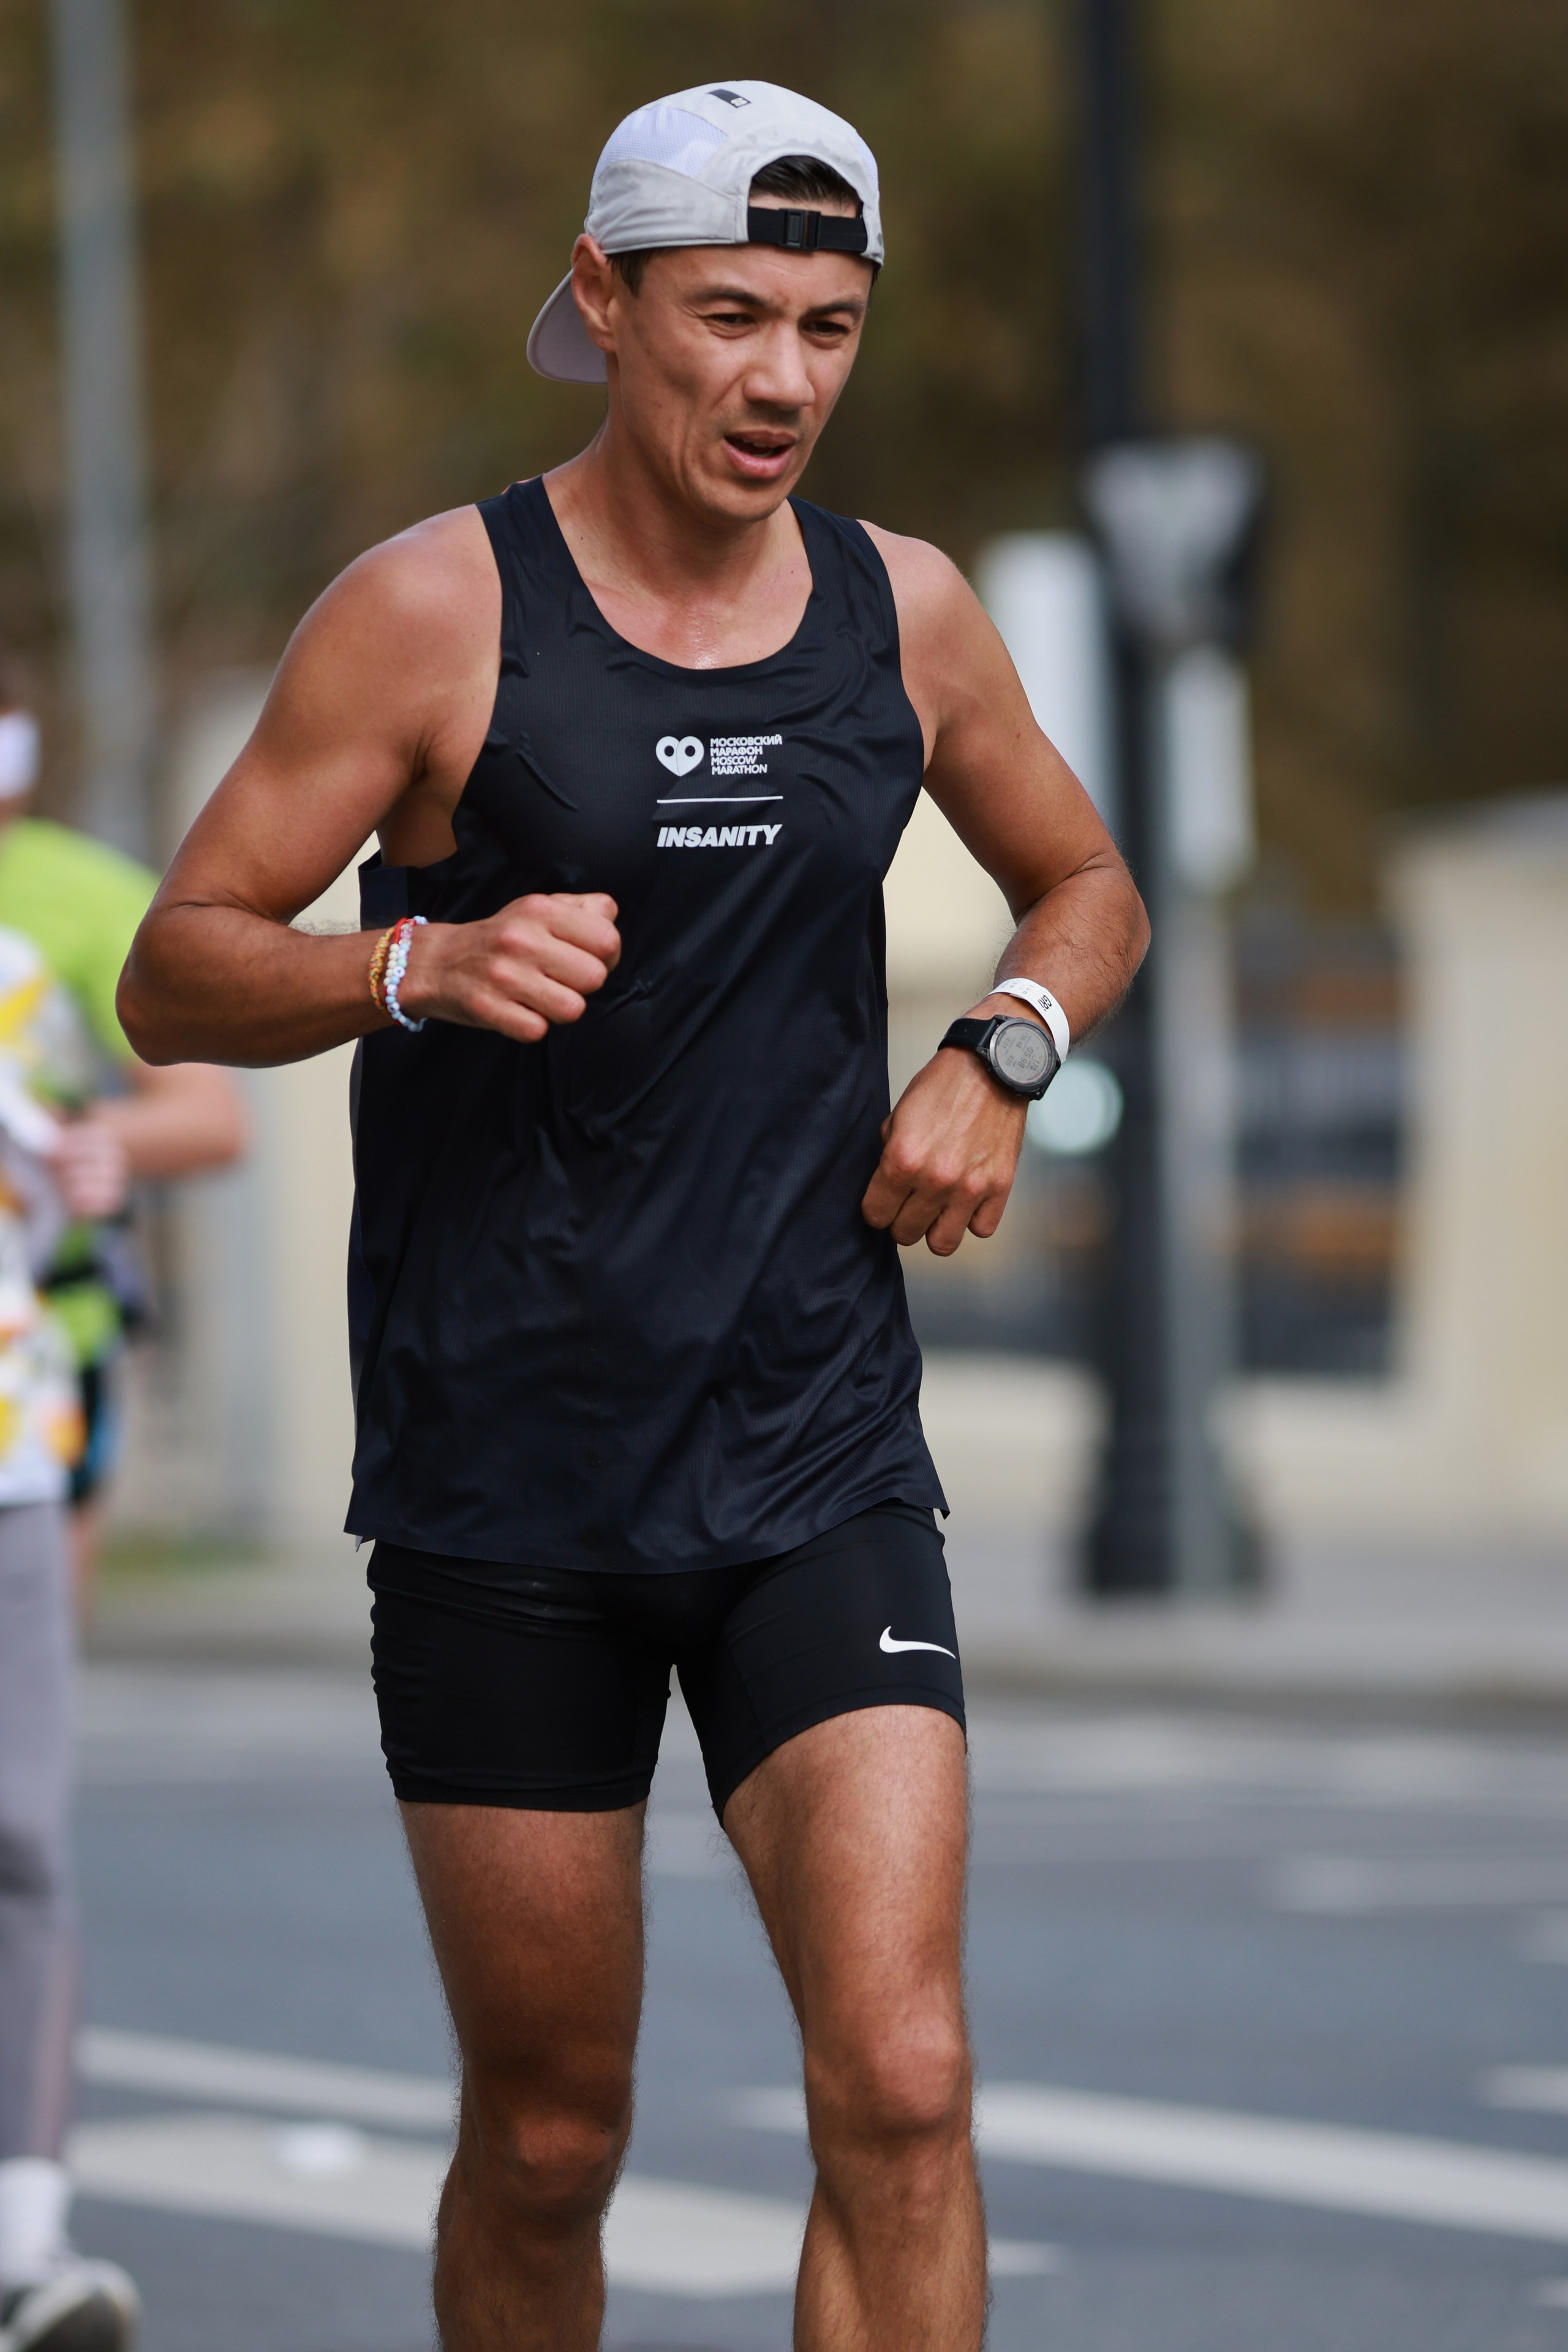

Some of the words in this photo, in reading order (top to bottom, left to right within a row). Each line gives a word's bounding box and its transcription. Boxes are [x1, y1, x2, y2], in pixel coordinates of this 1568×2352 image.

[710, 734, 783, 747] МОСКОВСКИЙ
[710, 746, 763, 756] МАРАФОН
[711, 755, 757, 766] MOSCOW
[712, 764, 767, 775] MARATHON
[657, 824, 783, 848] INSANITY
